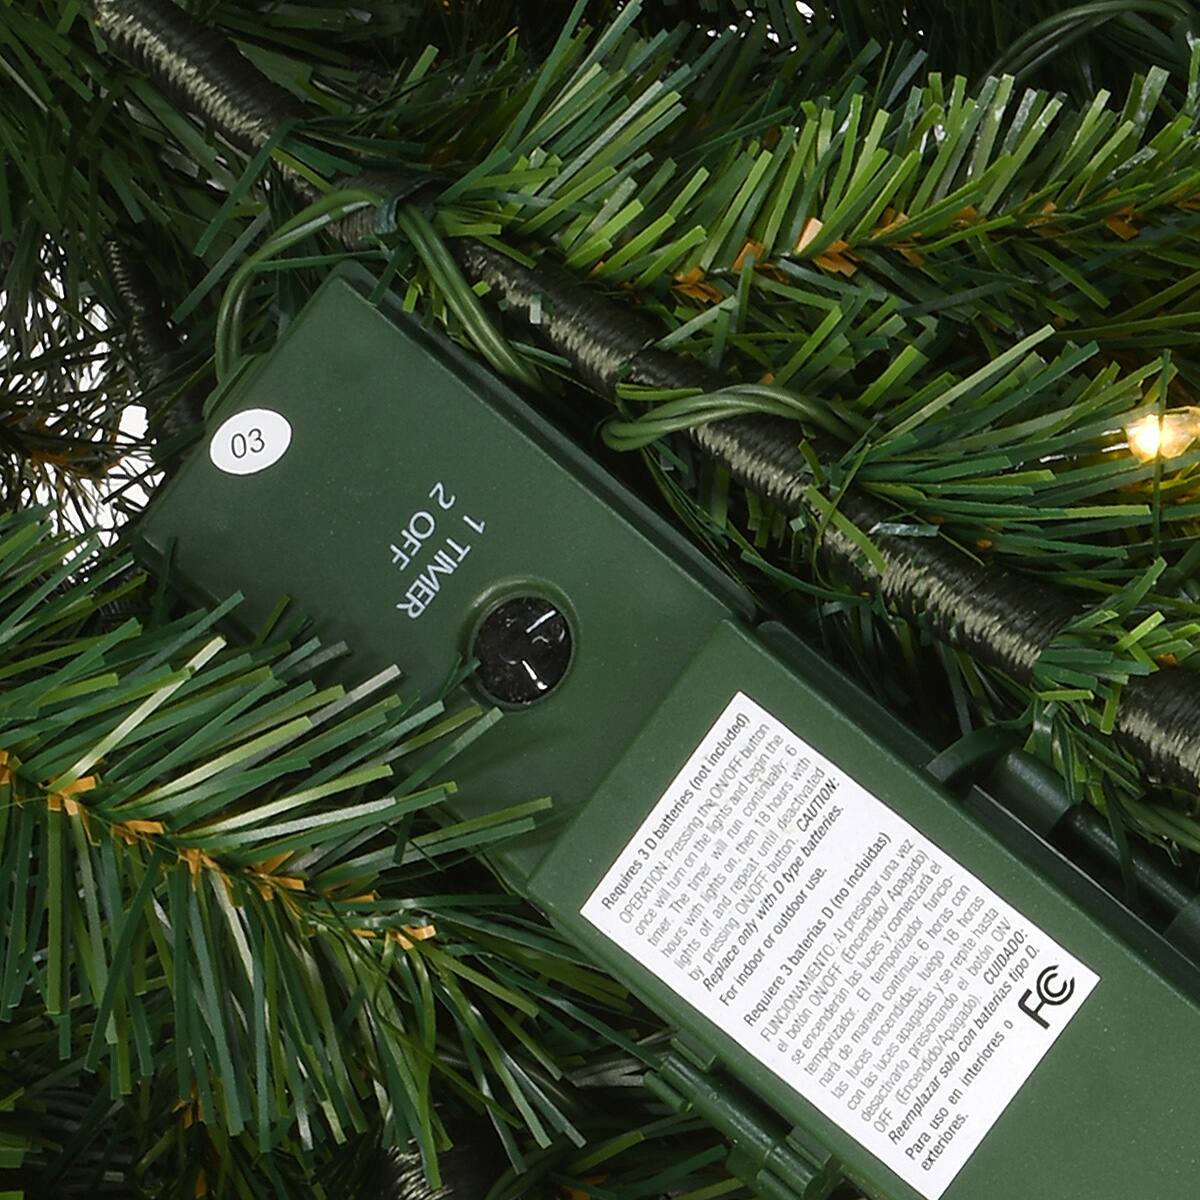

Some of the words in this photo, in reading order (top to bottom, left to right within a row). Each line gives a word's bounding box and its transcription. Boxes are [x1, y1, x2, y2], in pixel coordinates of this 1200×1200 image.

[231, 428, 265, 458] 03
[429, 482, 455, 509] 2
[390, 512, 435, 570] OFF
[396, 538, 471, 618] TIMER
[463, 516, 485, 533] 1
[663, 815, 705, 862] Pressing
[696, 798, 718, 818] the
[709, 755, 743, 799] ON/OFF
[738, 723, 770, 760] button
[688, 764, 712, 791] (not
[704, 712, 751, 767] included)
[634, 908, 657, 936] once
[653, 887, 671, 908] will
[666, 866, 687, 890] turn
[683, 851, 699, 868] on
[693, 833, 712, 853] the
[705, 804, 733, 834] lights
[729, 780, 749, 806] and
[742, 753, 770, 785] begin
[764, 734, 784, 754] the
[637, 848, 650, 861] 3
[643, 837, 658, 851] D
[651, 788, 695, 840] batteries
[660, 926, 688, 958] hours
[684, 902, 705, 927] with
[699, 873, 727, 904] lights
[735, 829, 759, 855] then
[754, 810, 771, 827] 18
[765, 781, 794, 813] hours
[791, 757, 812, 781] with
[668, 893, 690, 914] The
[687, 862, 711, 892] timer
[711, 838, 728, 860] will
[726, 819, 744, 840] run
[784, 744, 798, 757] 6
[674, 938, 701, 970] lights
[699, 917, 714, 937] off
[712, 894, 732, 920] and
[729, 857, 760, 895] repeat
[757, 829, 779, 857] until
[777, 766, 826, 830] deactivated
[687, 964, 705, 982] by
[702, 917, 740, 965] pressing
[734, 870, 769, 915] ON/OFF
[795, 777, 840, 833] CAUTION:
[601, 859, 643, 911] Requires
[702, 944, 740, 993] Replace
[737, 918, 759, 946] only
[755, 892, 778, 921] with
[772, 879, 786, 895] D
[781, 855, 805, 884] type
[799, 805, 844, 858] batteries.
[718, 984, 739, 1007] For
[733, 947, 766, 987] indoor
[762, 933, 776, 949] or
[772, 889, 808, 935] outdoor
[804, 867, 828, 891] use.
[743, 975, 786, 1028] Requiere
[779, 963, 793, 977] 3
[820, 906, 835, 920] D
[829, 887, 850, 910] (no
[843, 831, 892, 889] incluidas)
[832, 927, 848, 944] Al
[843, 880, 883, 933] presionar
[879, 859, 900, 882] una
[895, 838, 914, 859] vez
[856, 986, 871, 1002] El
[869, 915, 924, 985] temporizador
[922, 875, 953, 912] funcio-
[777, 1038, 789, 1053] el
[808, 962, 843, 1007] ON/OFF
[791, 1048, 806, 1065] se
[844, 969, 863, 988] las
[857, 940, 885, 970] luces
[880, 931, 892, 943] y
[929, 859, 942, 875] el
[830, 1080, 849, 1100] las
[845, 1048, 873, 1079] luces
[916, 950, 945, 981] luego
[942, 928, 960, 946] 18
[956, 895, 985, 928] horas
[838, 1044, 853, 1061] de
[850, 1002, 885, 1044] manera
[916, 938, 930, 951] 6
[925, 907, 954, 940] horas
[951, 884, 971, 907] con
[847, 1088, 866, 1111] con
[860, 1071, 878, 1089] las
[872, 1042, 900, 1072] luces
[895, 991, 938, 1044] apagadas
[933, 982, 945, 995] y
[939, 968, 954, 985] se
[949, 937, 977, 970] repite
[970, 907, 1000, 939] hasta
[861, 1059, 910, 1122] desactivarlo
[908, 992, 959, 1060] presionando
[958, 976, 969, 991] el
[990, 916, 1011, 942] ON/
[873, 1107, 893, 1133] OFF
[983, 928, 1029, 986] CUIDADO:
[887, 1075, 941, 1145] Reemplazar
[938, 1050, 961, 1079] solo
[958, 1028, 978, 1053] con
[1007, 957, 1030, 983] tipo
[1024, 944, 1041, 960] D.
[904, 1131, 932, 1161] Para
[929, 1106, 950, 1130] uso
[947, 1088, 964, 1105] en
[960, 1031, 1006, 1087] interiores
[1003, 1019, 1014, 1030] o
[920, 1113, 969, 1172] exteriores.
